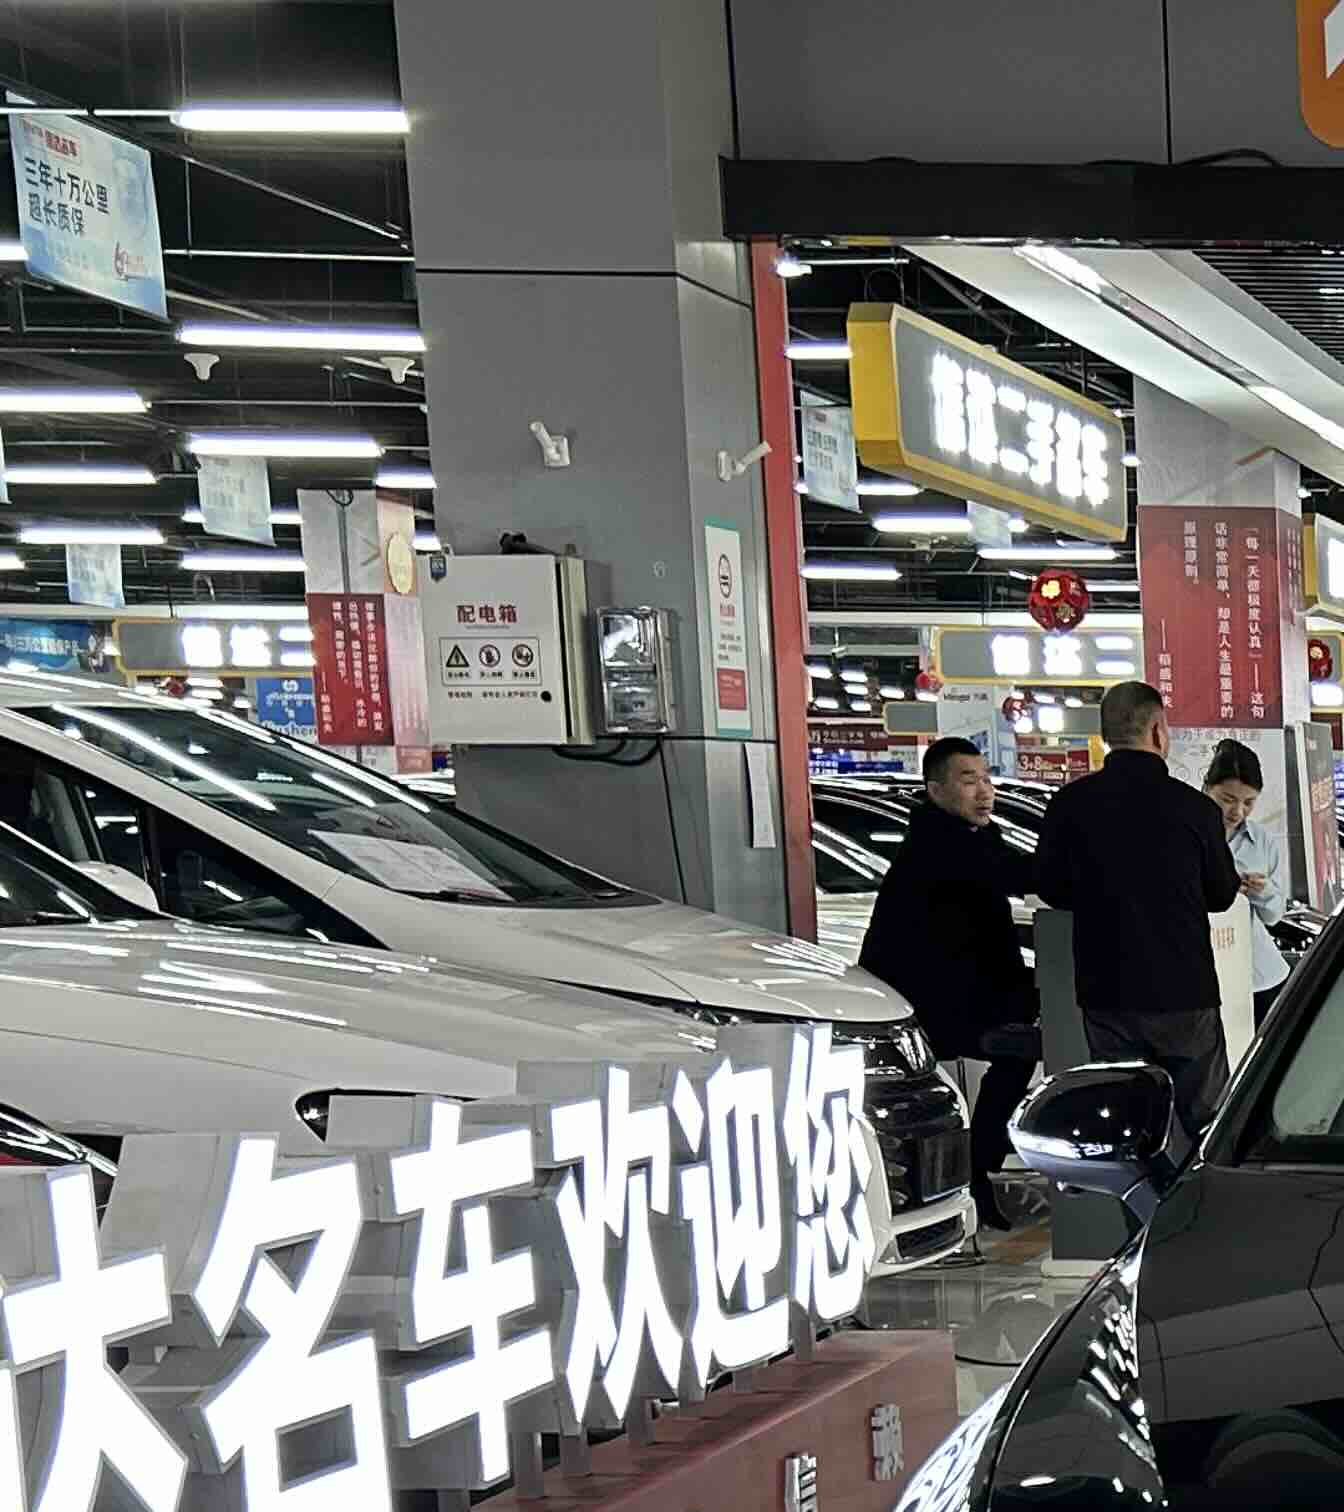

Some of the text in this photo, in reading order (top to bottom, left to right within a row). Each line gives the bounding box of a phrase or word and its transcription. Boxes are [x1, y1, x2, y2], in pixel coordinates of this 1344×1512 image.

[25, 156, 110, 215] 三年十万公里
[456, 604, 518, 623] 配电箱
